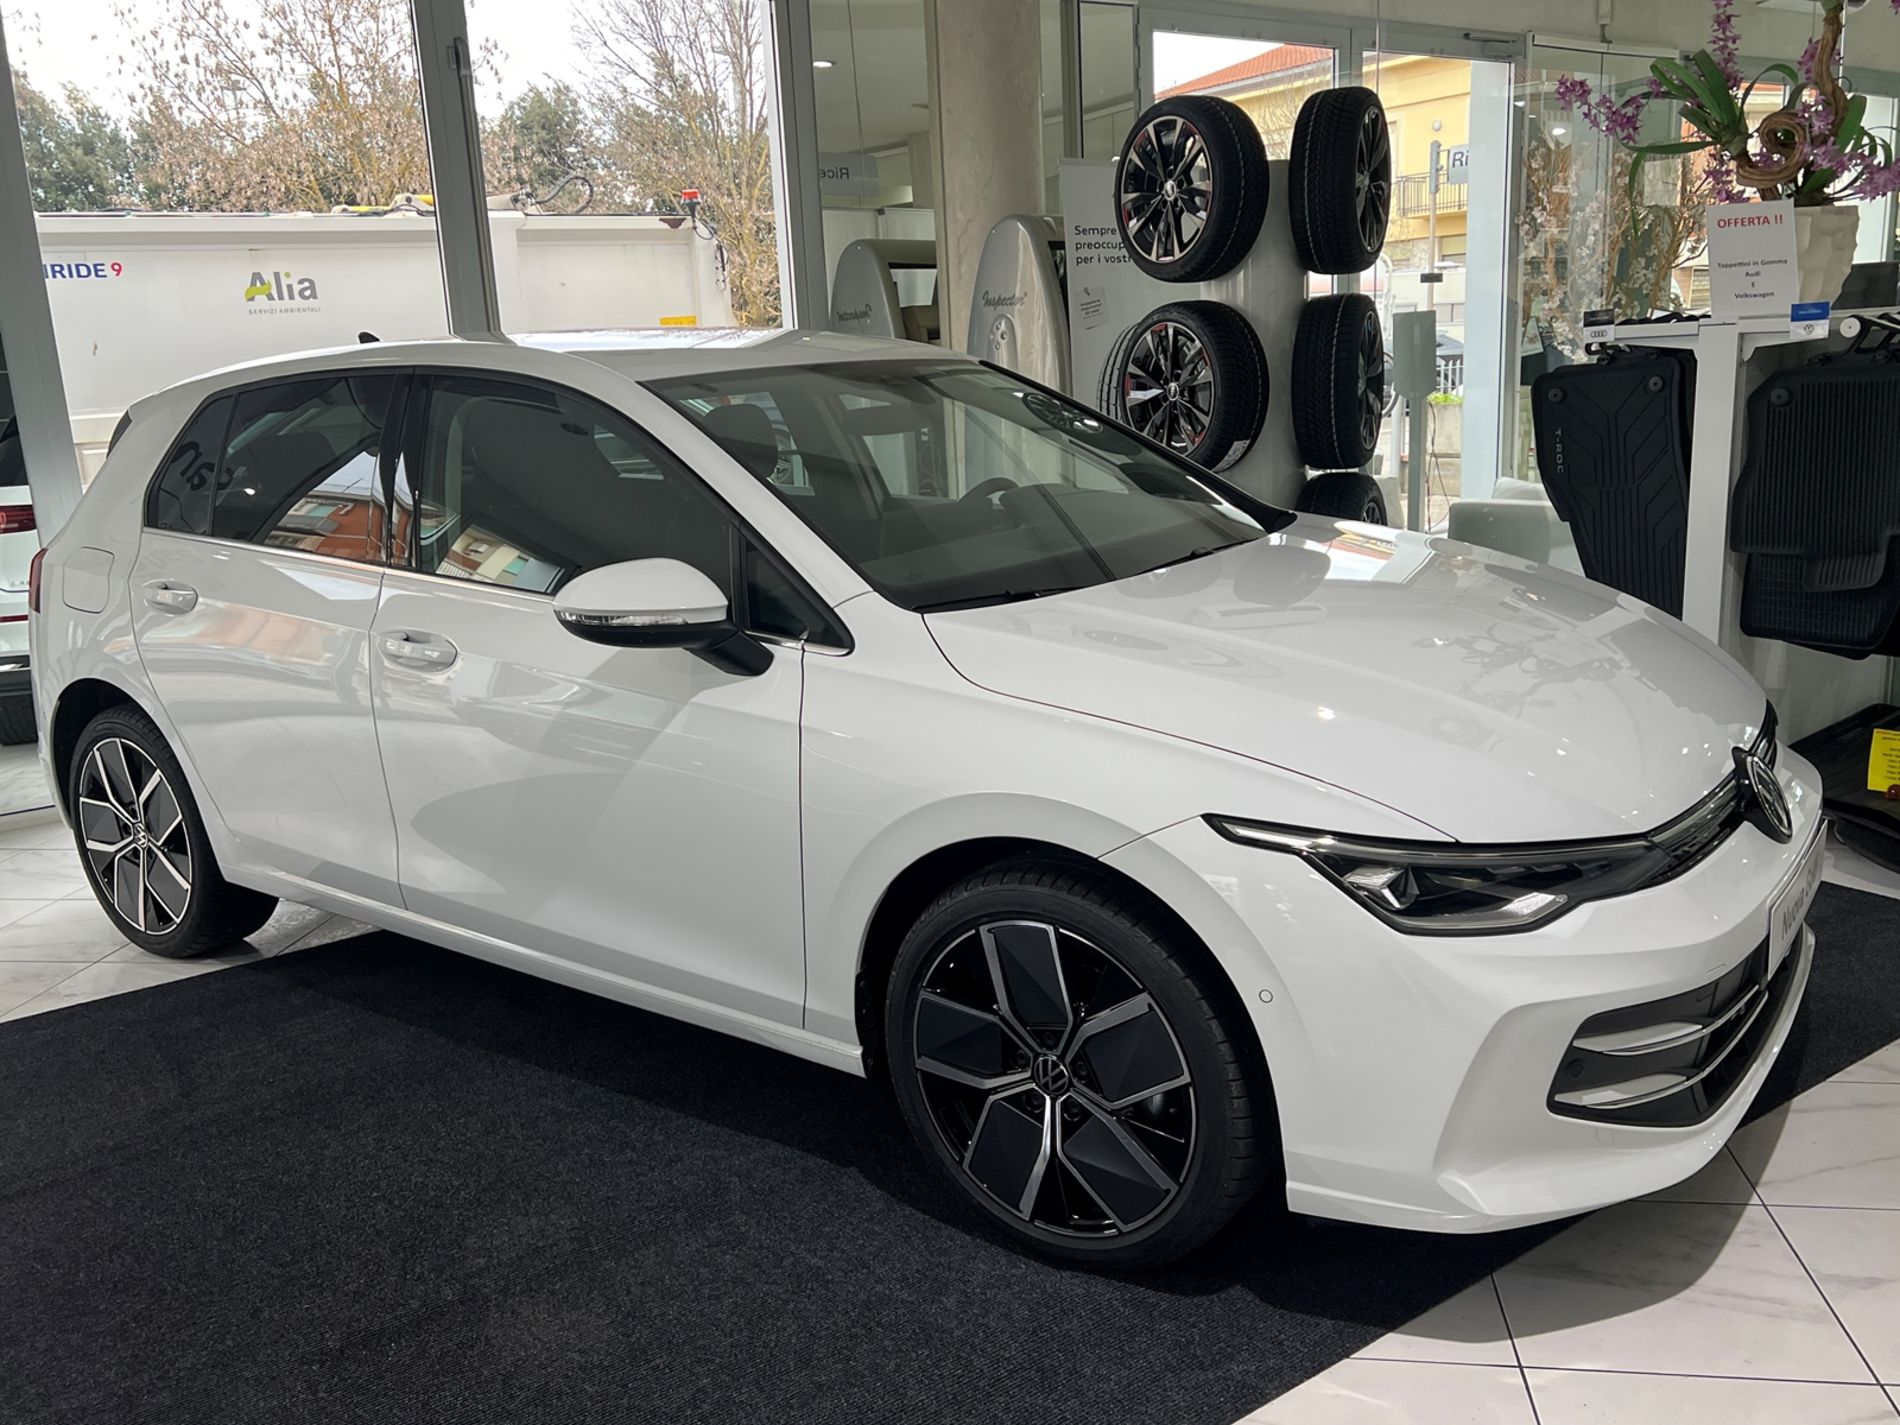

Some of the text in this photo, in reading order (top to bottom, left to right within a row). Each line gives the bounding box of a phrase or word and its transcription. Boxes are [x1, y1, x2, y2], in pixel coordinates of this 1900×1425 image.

[1717, 216, 1770, 229] OFFERTA
[1074, 224, 1117, 236] Sempre
[1076, 255, 1094, 266] per
[1097, 253, 1101, 263] i
[110, 262, 122, 277] 9
[245, 271, 319, 302] Alia
[1733, 291, 1775, 299] Volkswagen
[248, 306, 321, 316] SERVIZI AMBIENTALI
[1555, 427, 1565, 474] T-ROC
